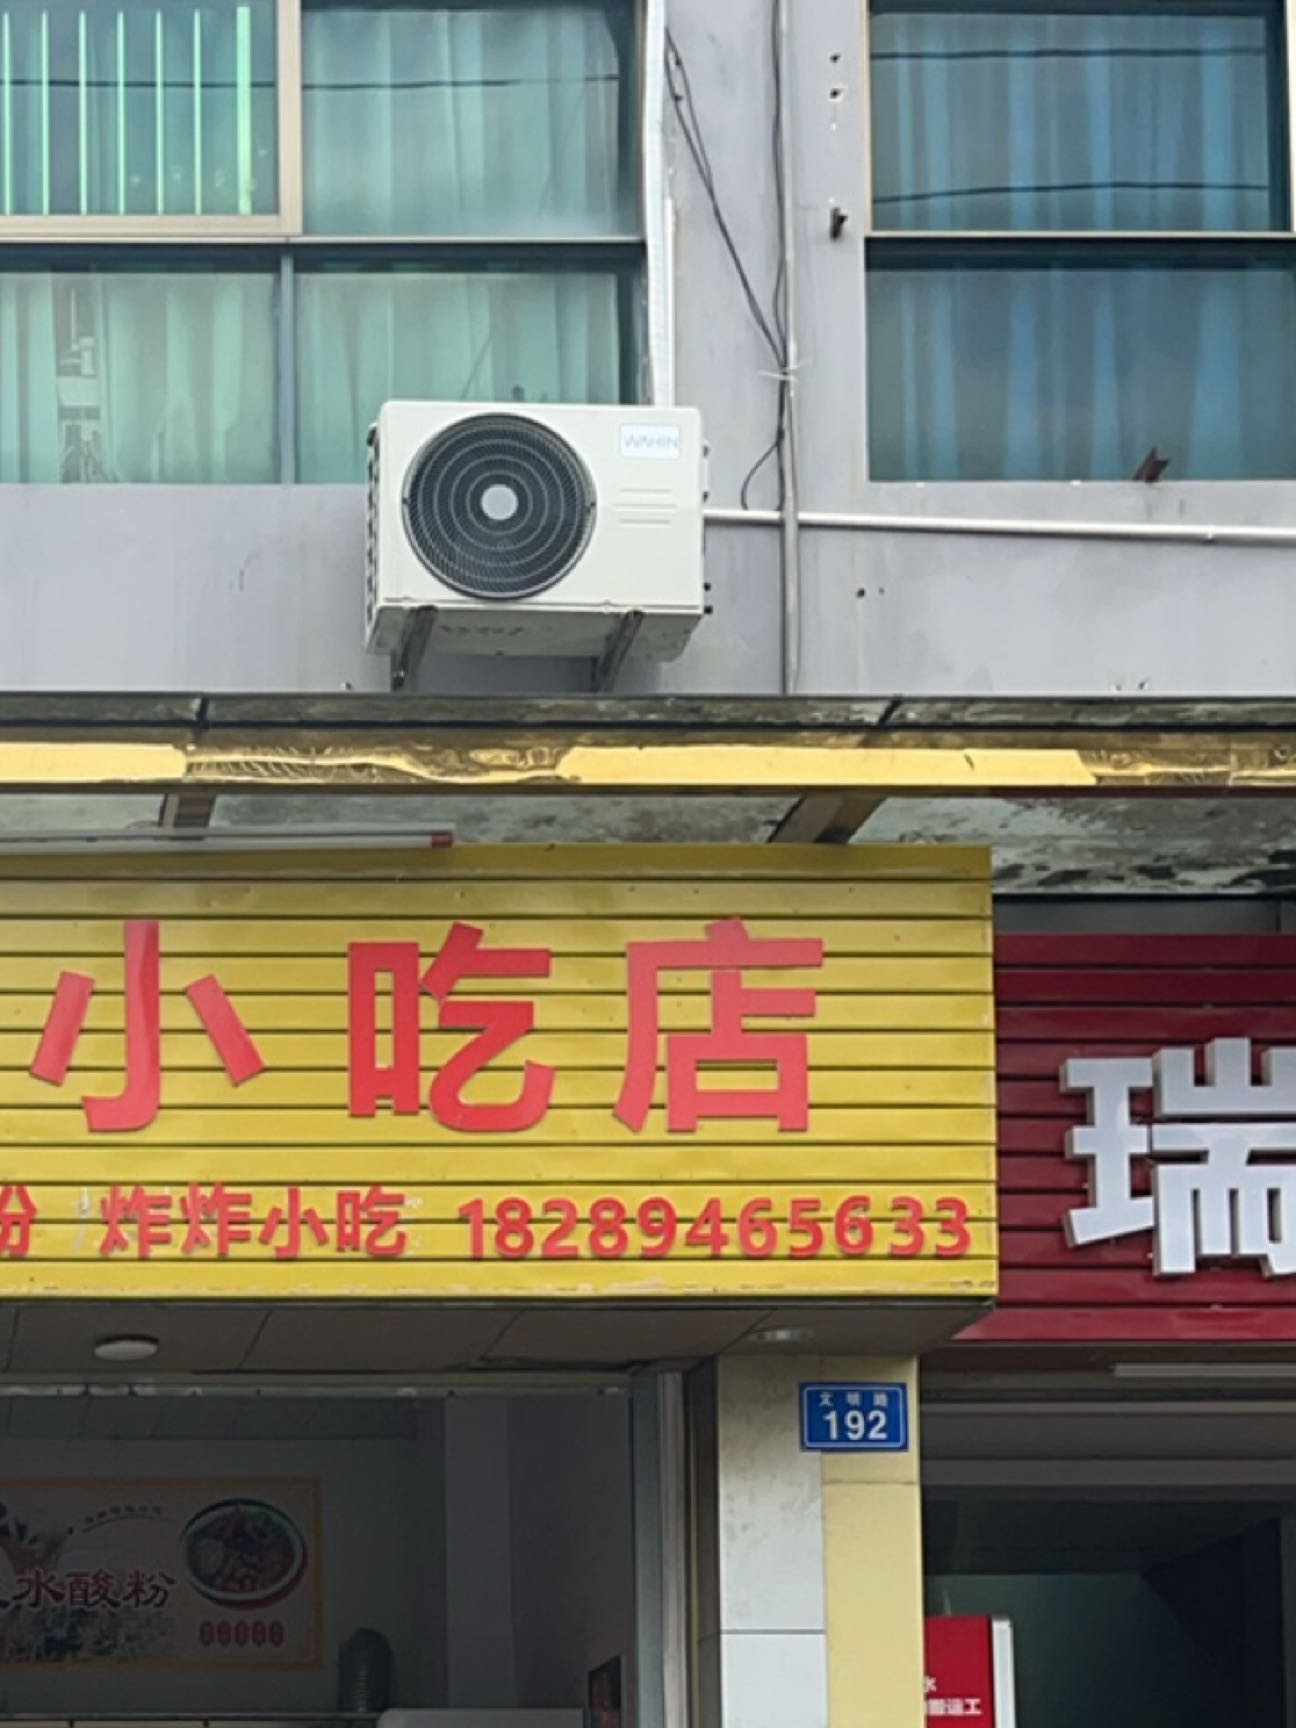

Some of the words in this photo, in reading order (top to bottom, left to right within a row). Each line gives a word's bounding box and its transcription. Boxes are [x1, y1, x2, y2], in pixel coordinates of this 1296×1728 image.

[1060, 1037, 1296, 1279] 瑞
[100, 1182, 407, 1260] 炸炸小吃
[457, 1197, 973, 1260] 18289465633
[823, 1410, 888, 1440] 192
